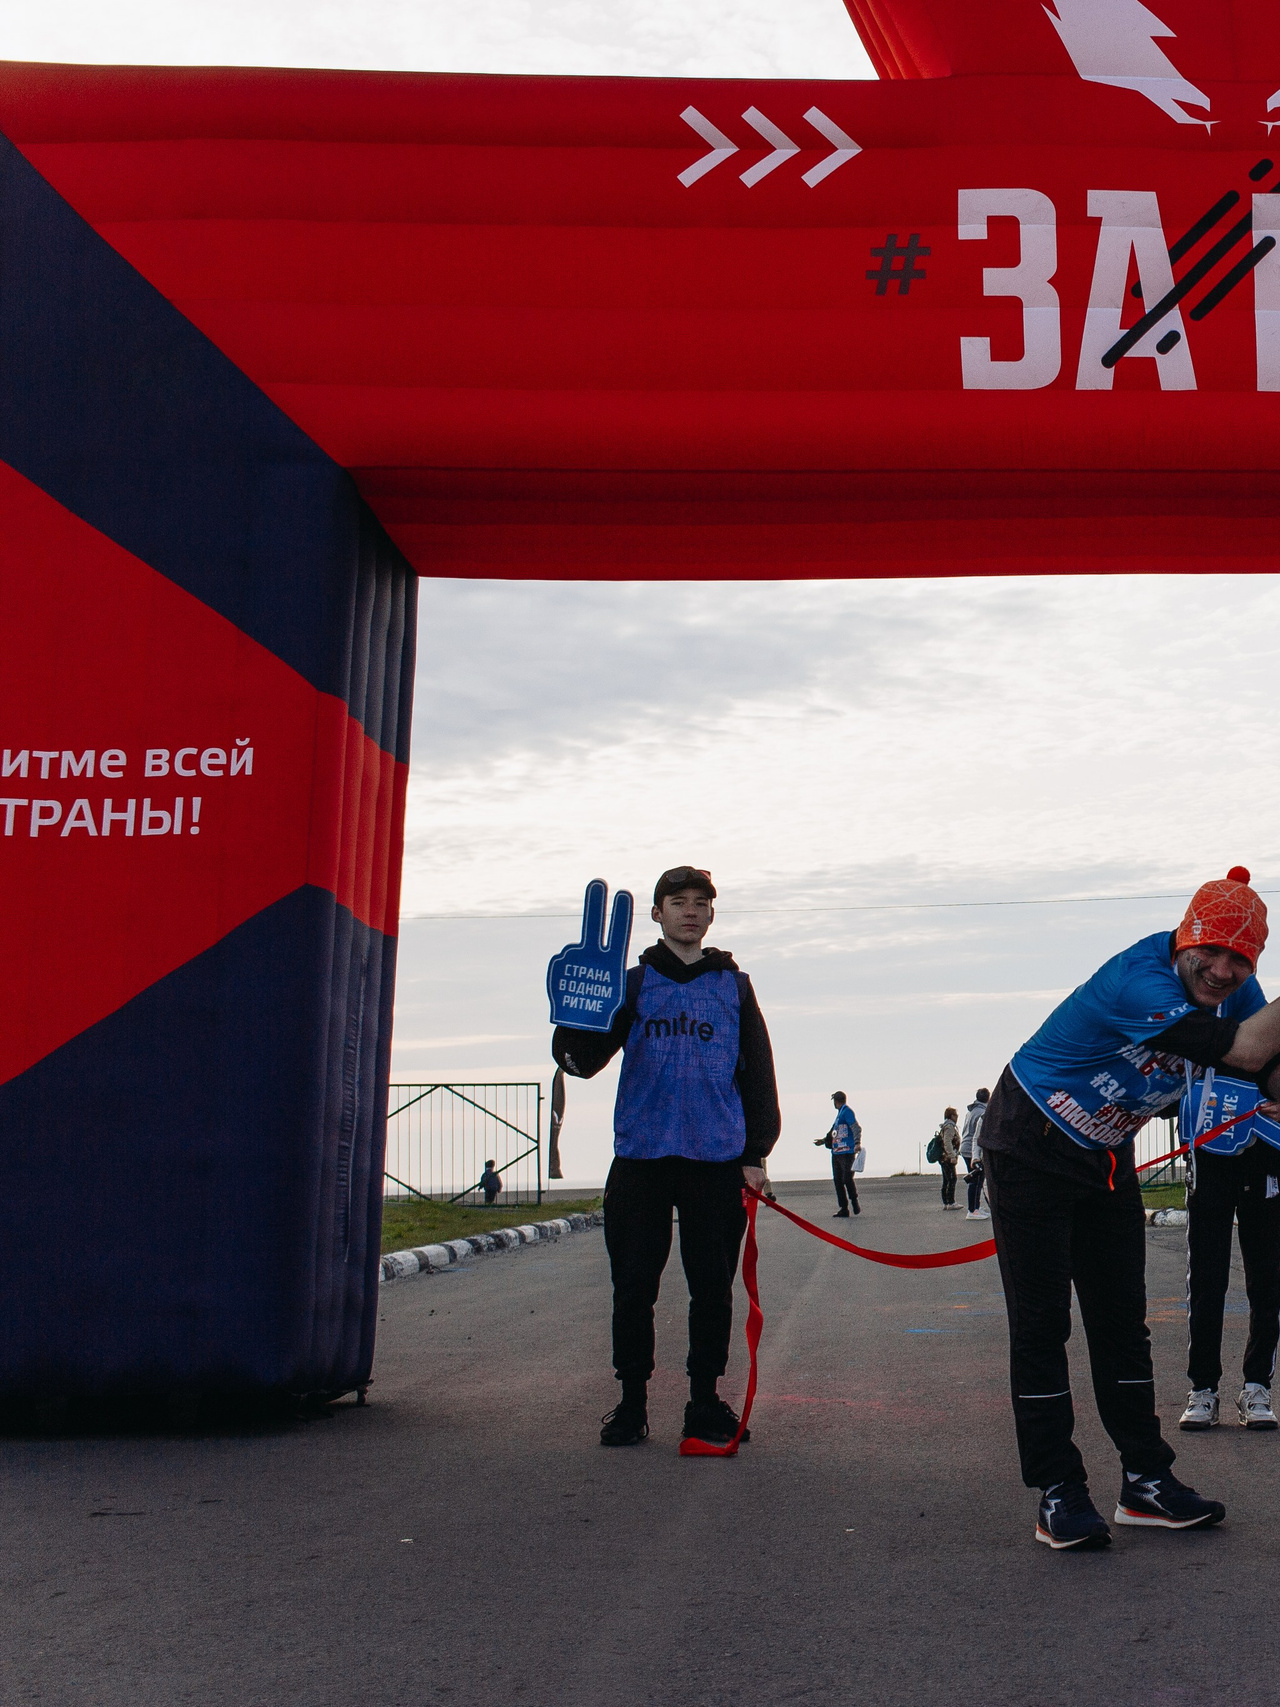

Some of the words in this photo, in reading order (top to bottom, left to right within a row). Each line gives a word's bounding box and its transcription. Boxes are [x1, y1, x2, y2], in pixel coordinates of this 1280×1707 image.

[144, 737, 254, 778] всей
[0, 796, 202, 838] ТРАНЫ!
[564, 964, 611, 983] СТРАНА
[559, 979, 567, 991] В
[568, 980, 613, 999] ОДНОМ
[562, 995, 604, 1013] РИТМЕ
[644, 1011, 714, 1042] mitre
